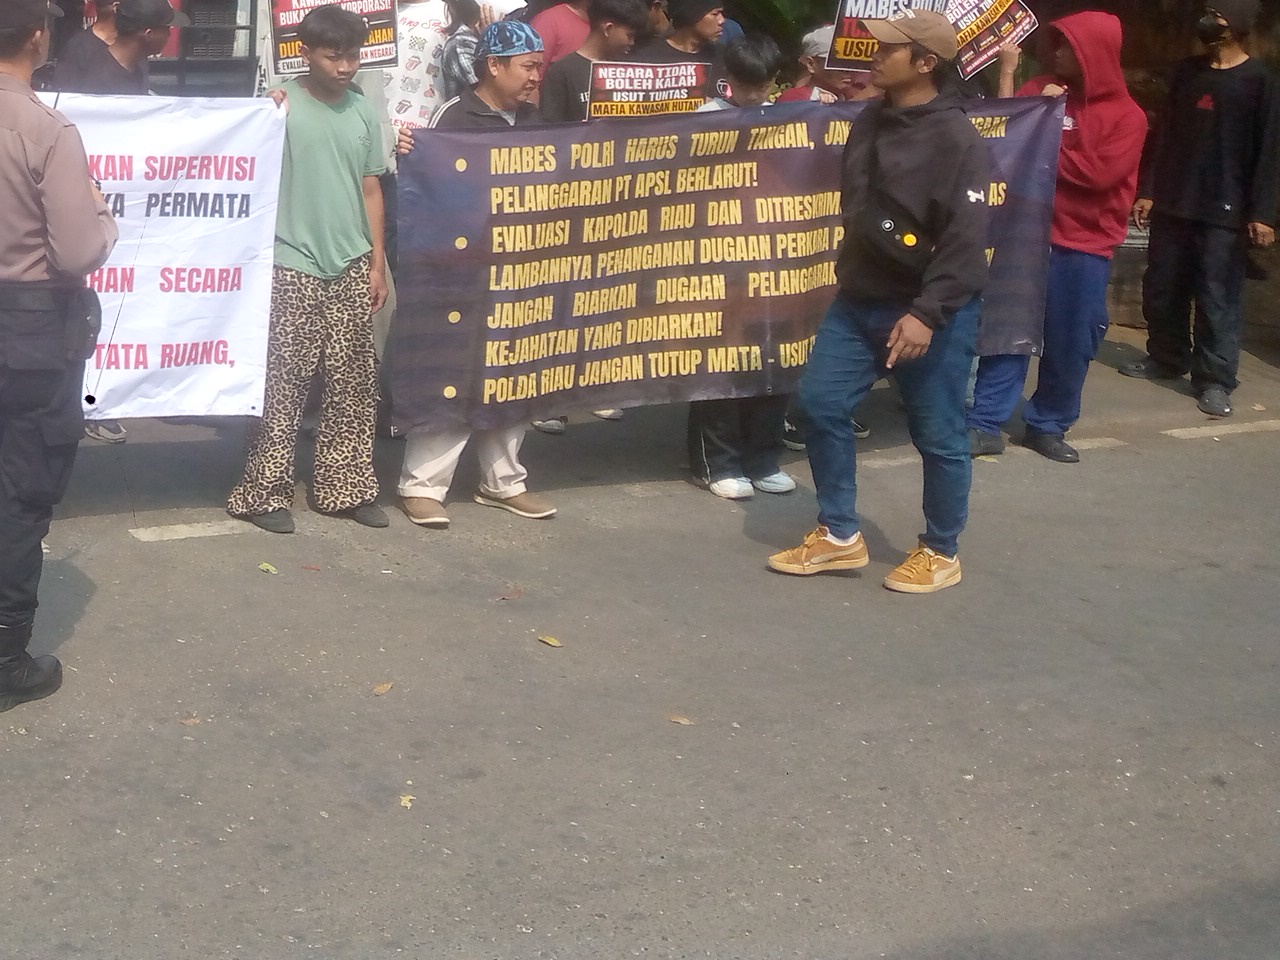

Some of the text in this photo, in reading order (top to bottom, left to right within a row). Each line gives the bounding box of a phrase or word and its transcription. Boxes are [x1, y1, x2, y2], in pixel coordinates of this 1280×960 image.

[958, 9, 980, 30] USUT
[598, 65, 697, 79] NEGARA TIDAK
[605, 76, 697, 90] BOLEH KALAH
[593, 103, 625, 115] MAFIA
[629, 102, 669, 115] KAWASAN
[612, 89, 688, 102] USUT TUNTAS
[490, 122, 815, 175] MABES POLRI HARUS TURUN TANGAN,
[144, 155, 256, 181] SUPERVISI
[491, 161, 758, 215] PELANGGARAN PT APSL BERLARUT!
[145, 192, 251, 218] PERMATA
[492, 199, 743, 253] EVALUASI KAPOLDA RIAU DAN
[489, 227, 830, 291] LAMBANNYA PENANGANAN DUGAAN PERKARA
[159, 266, 242, 293] SECARA
[487, 274, 726, 330] JANGAN BIARKAN DUGAAN
[485, 312, 723, 367] KEJAHATAN YANG DIBIARKAN!
[95, 343, 148, 370] TATA
[160, 339, 236, 370] RUANG,
[483, 345, 763, 405] POLDA RIAU JANGAN TUTUP MATA
